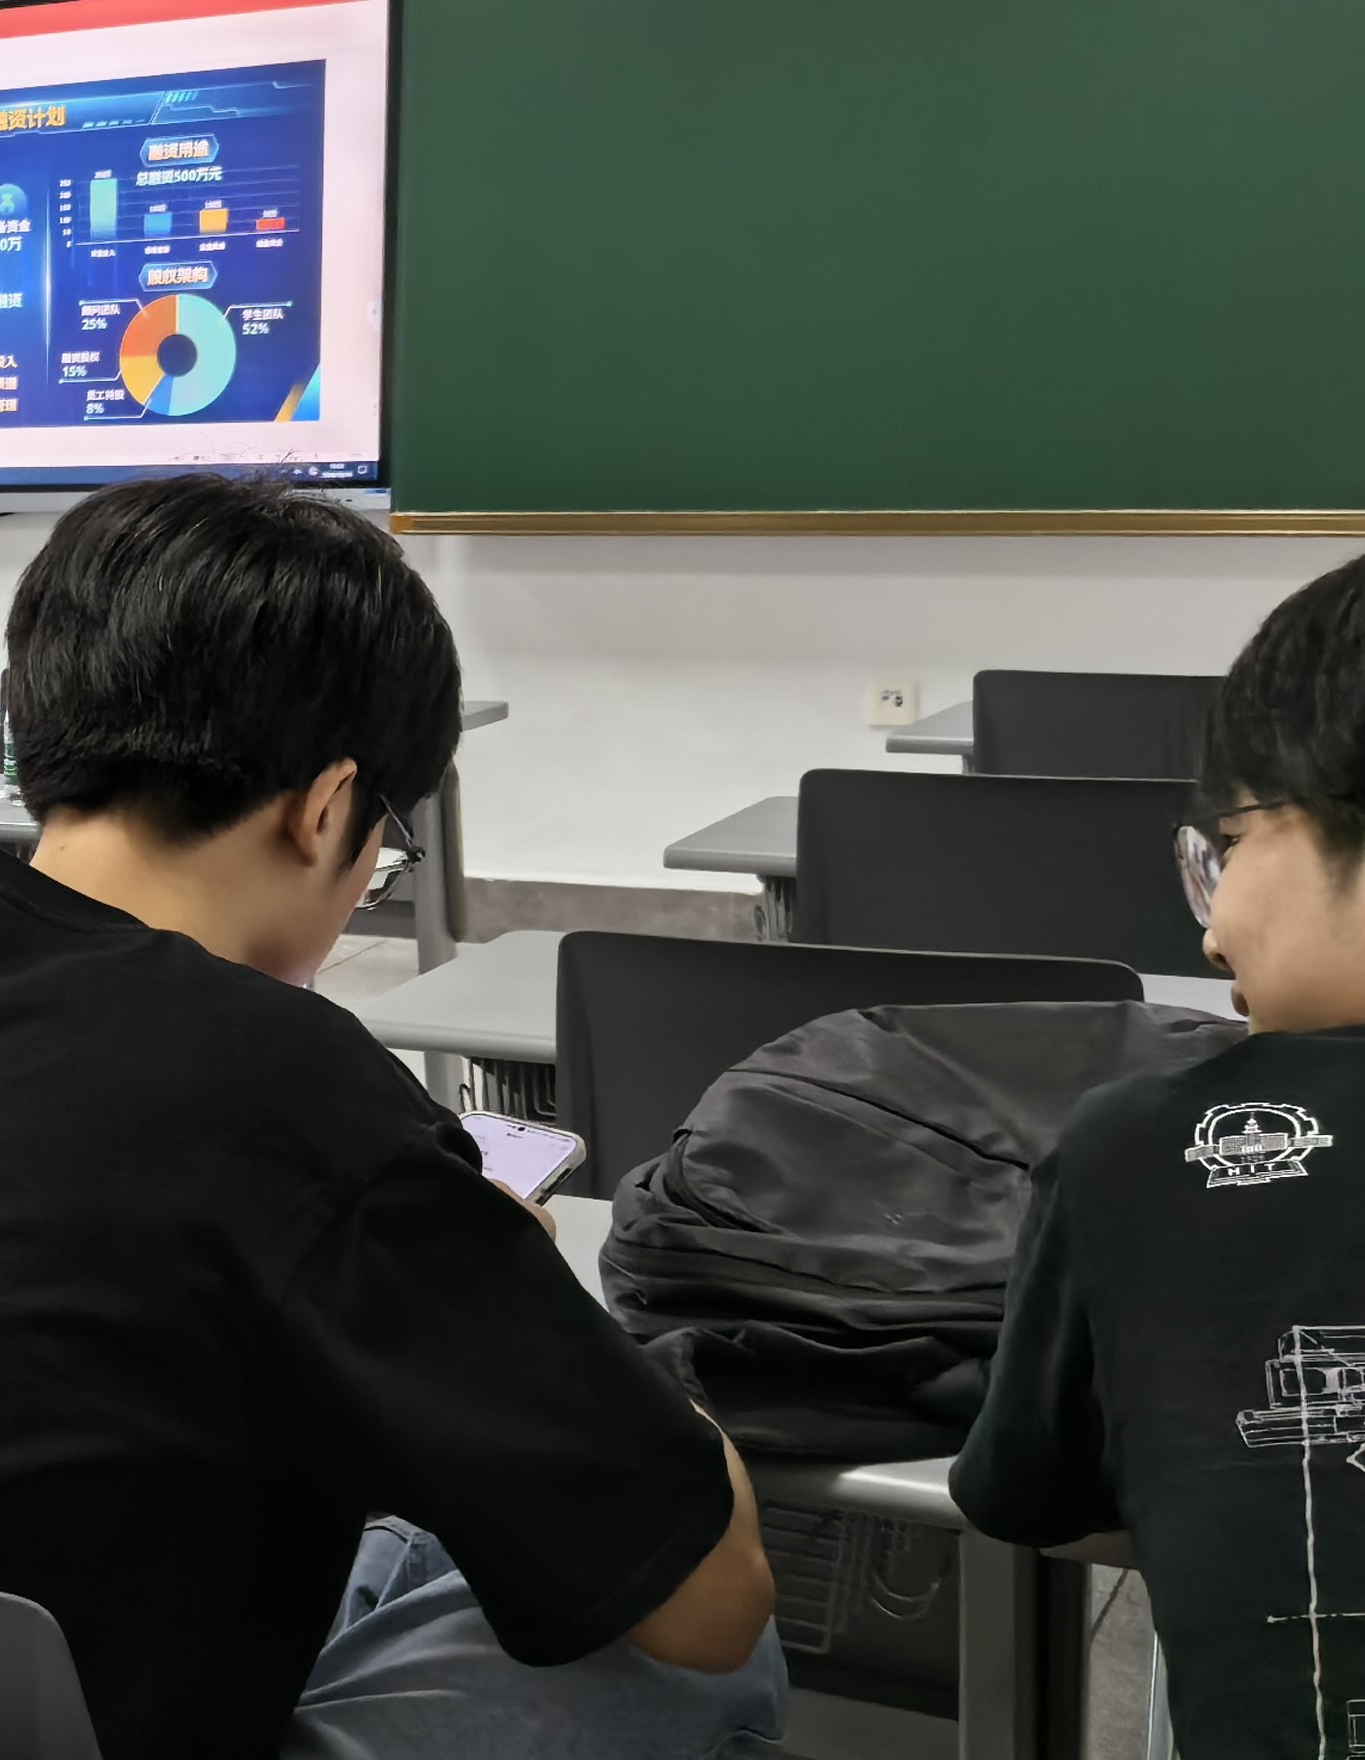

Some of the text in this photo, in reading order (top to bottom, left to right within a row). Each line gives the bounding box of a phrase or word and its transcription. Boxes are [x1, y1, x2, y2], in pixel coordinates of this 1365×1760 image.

[148, 140, 210, 160] 融资用途
[136, 166, 222, 186] 总融资500万元
[147, 267, 209, 286] 股权架构
[242, 309, 284, 320] 学生团队
[81, 318, 107, 330] 25%
[242, 322, 269, 335] 52%
[62, 365, 87, 377] 15%
[85, 403, 104, 414] 8%
